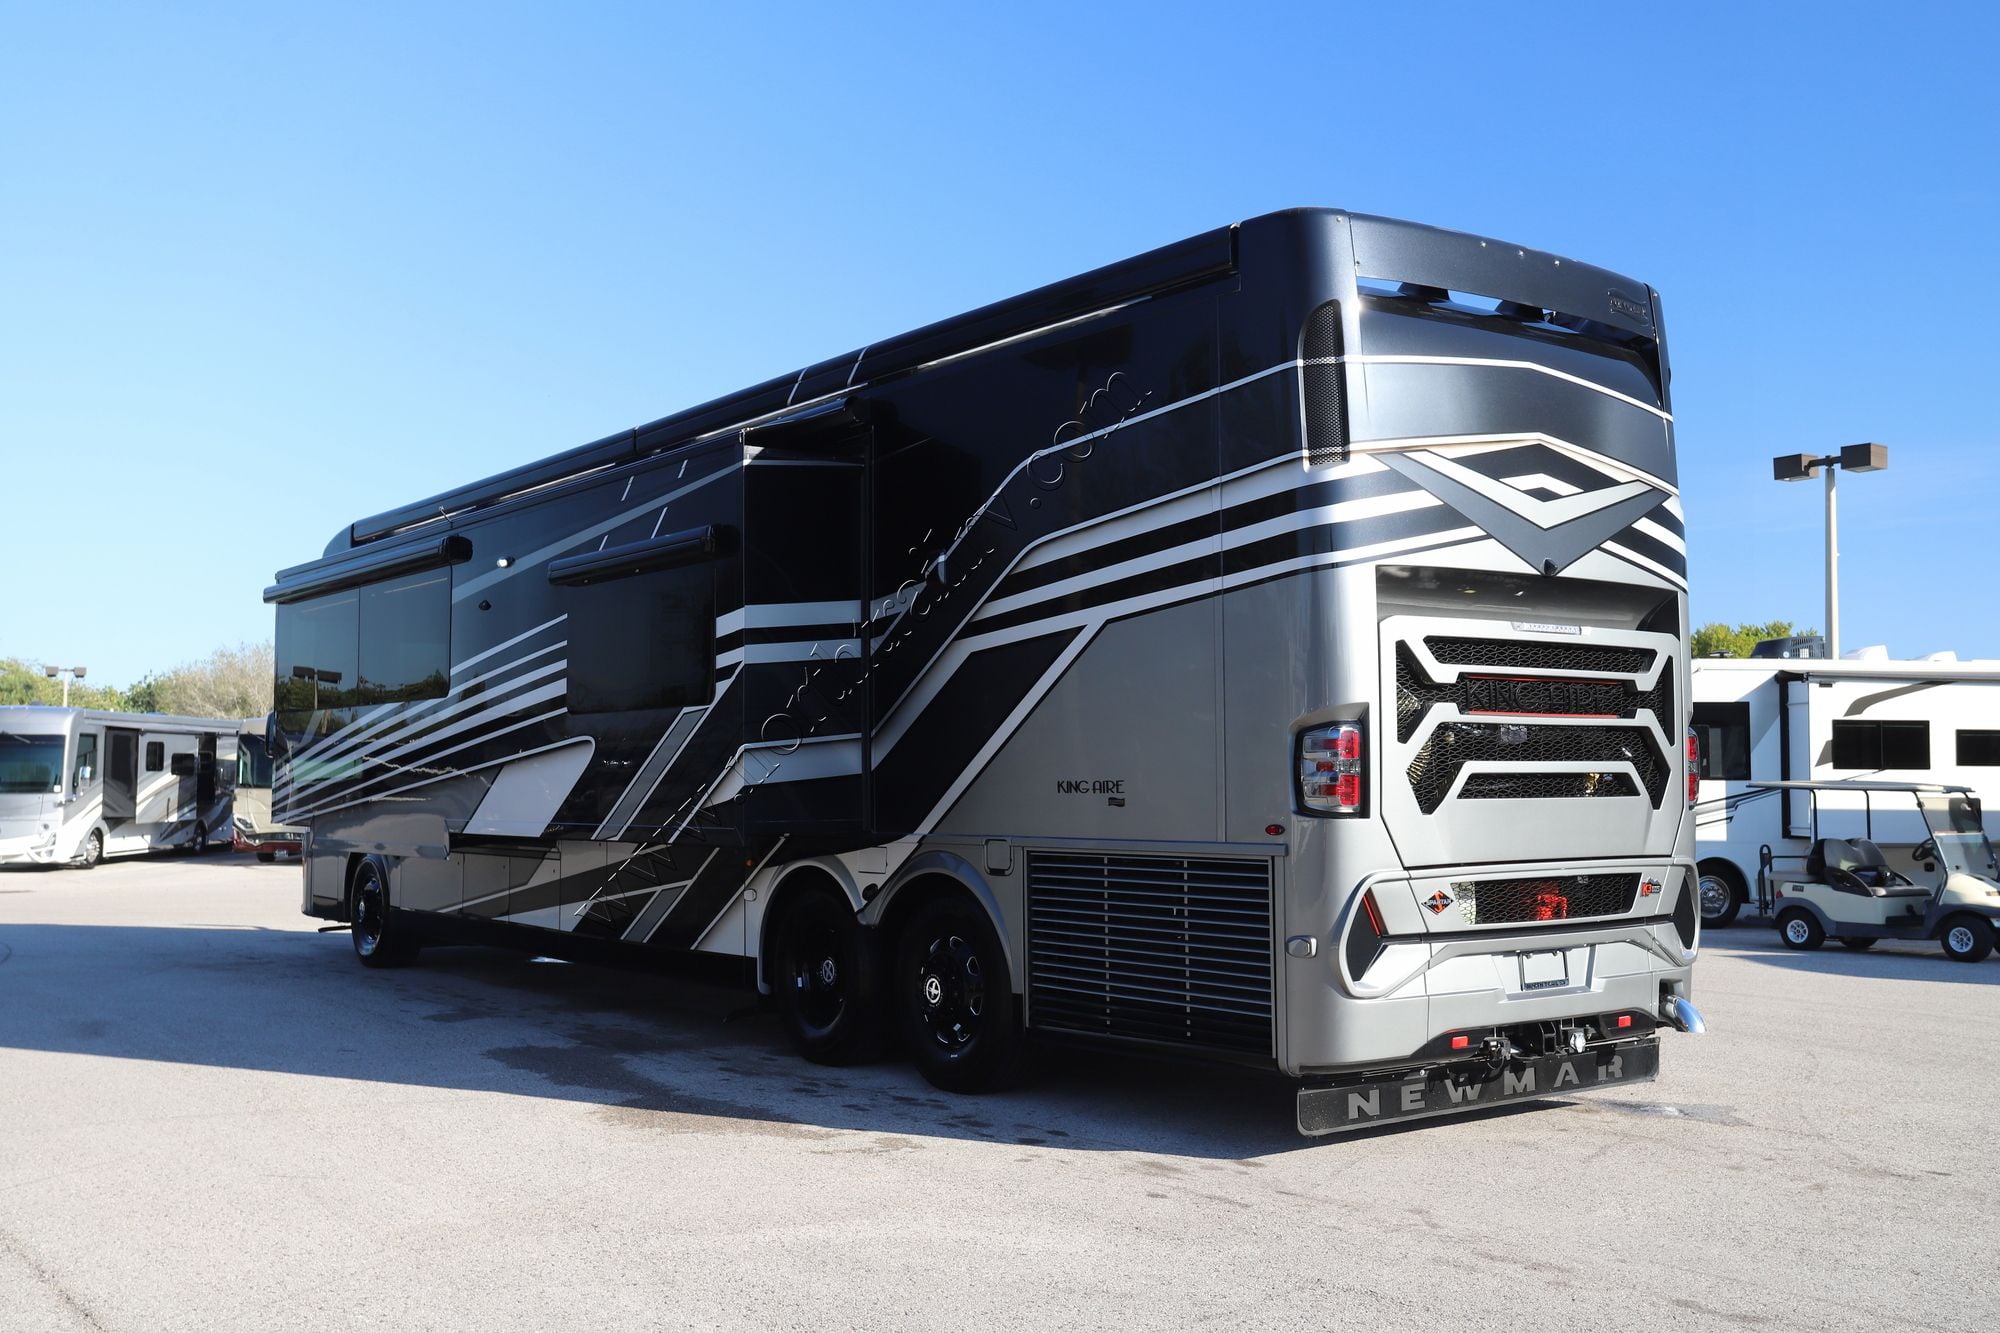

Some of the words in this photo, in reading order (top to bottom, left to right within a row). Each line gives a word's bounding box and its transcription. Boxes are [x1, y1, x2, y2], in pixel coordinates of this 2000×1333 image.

[1057, 780, 1089, 794] KING
[1092, 779, 1126, 794] AIRE
[1347, 1055, 1624, 1120] NEWMAR
